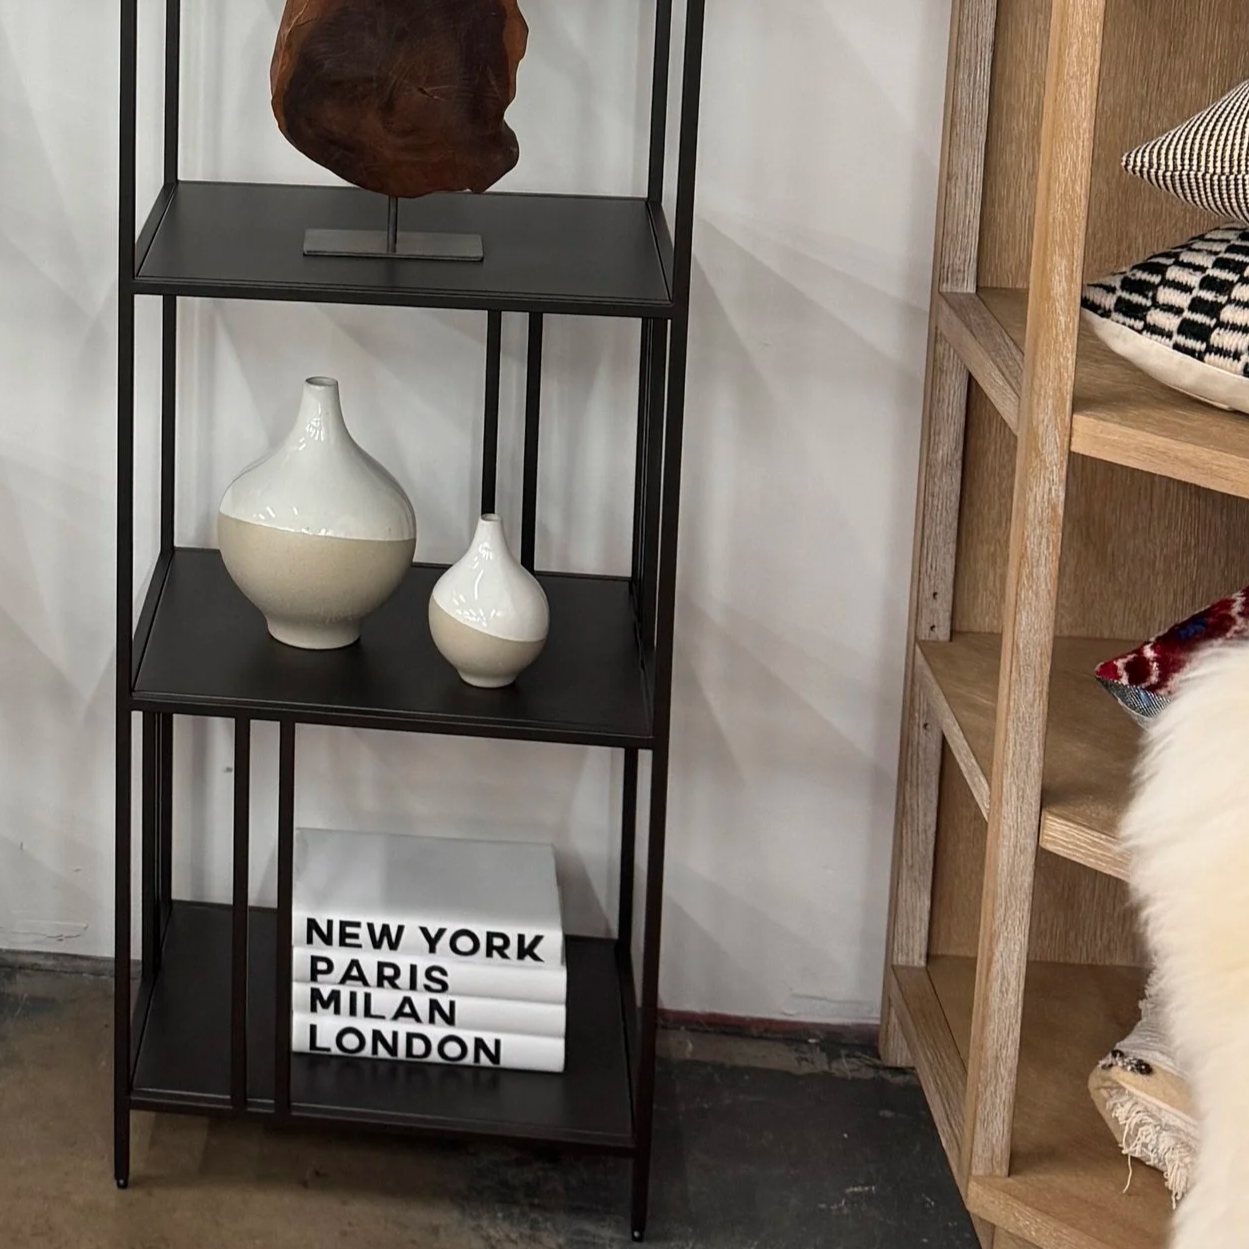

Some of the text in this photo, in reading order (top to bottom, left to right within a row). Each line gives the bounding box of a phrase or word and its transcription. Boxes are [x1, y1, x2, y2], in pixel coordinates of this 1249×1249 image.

[306, 917, 545, 962] NEW YORK
[310, 955, 449, 994] PARIS
[310, 987, 456, 1027] MILAN
[309, 1024, 501, 1065] LONDON
